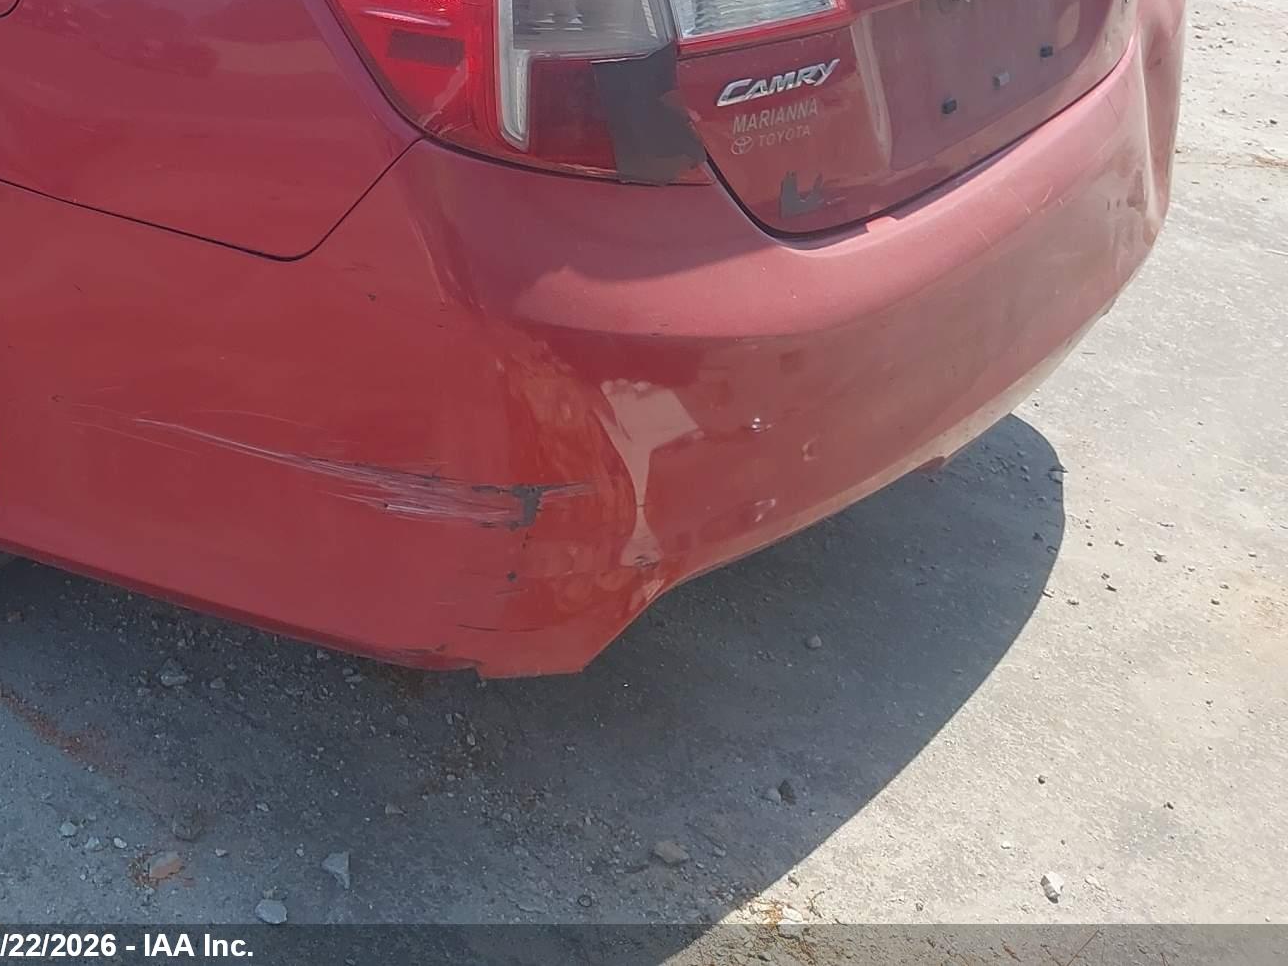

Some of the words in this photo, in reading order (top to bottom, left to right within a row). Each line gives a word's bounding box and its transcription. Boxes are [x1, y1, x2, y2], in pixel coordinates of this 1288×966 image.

[716, 58, 841, 107] CAMRY
[732, 97, 818, 135] MARIANNA
[758, 124, 811, 147] TOYOTA
